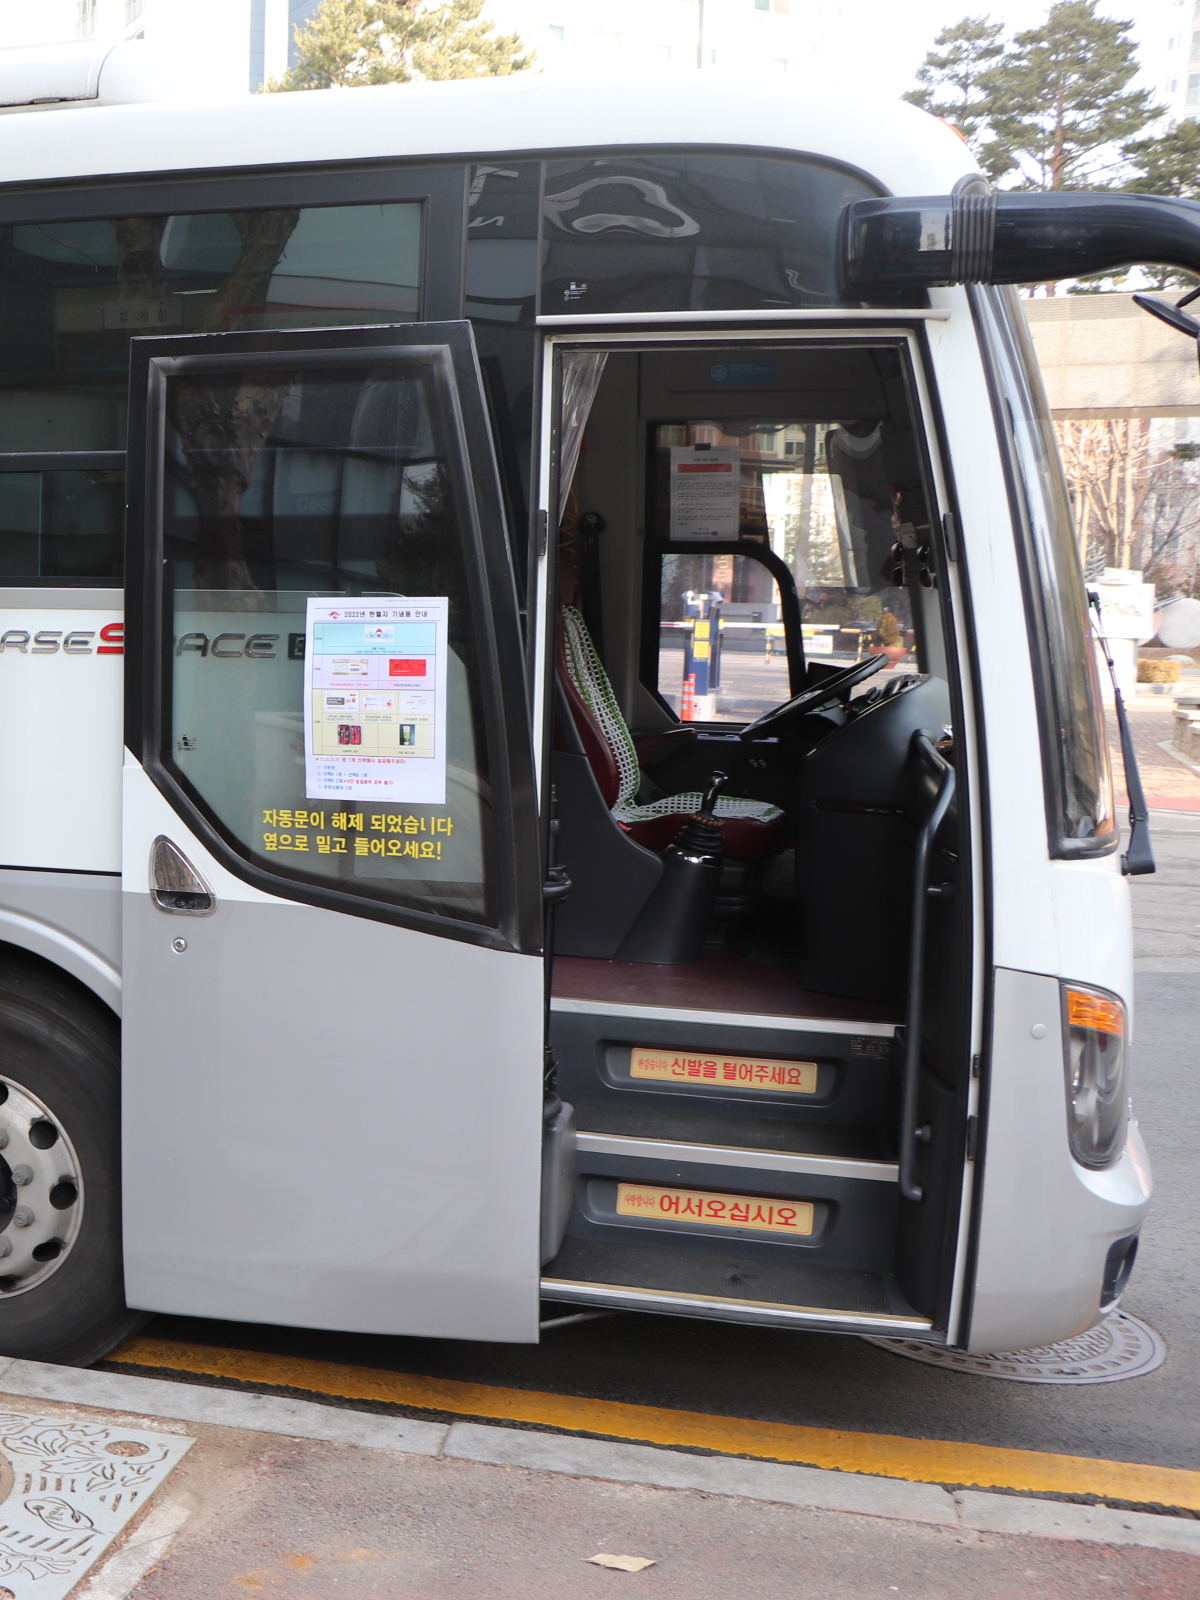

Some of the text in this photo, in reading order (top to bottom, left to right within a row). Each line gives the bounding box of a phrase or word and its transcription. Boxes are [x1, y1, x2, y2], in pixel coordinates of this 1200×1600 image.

[96, 622, 279, 658] SACE
[262, 809, 453, 836] 자동문이 해제 되었습니다
[263, 832, 442, 860] 옆으로 밀고 들어오세요!
[671, 1058, 717, 1079] 신발을
[722, 1062, 802, 1085] 털어주세요
[659, 1194, 798, 1227] 어서오십시오
